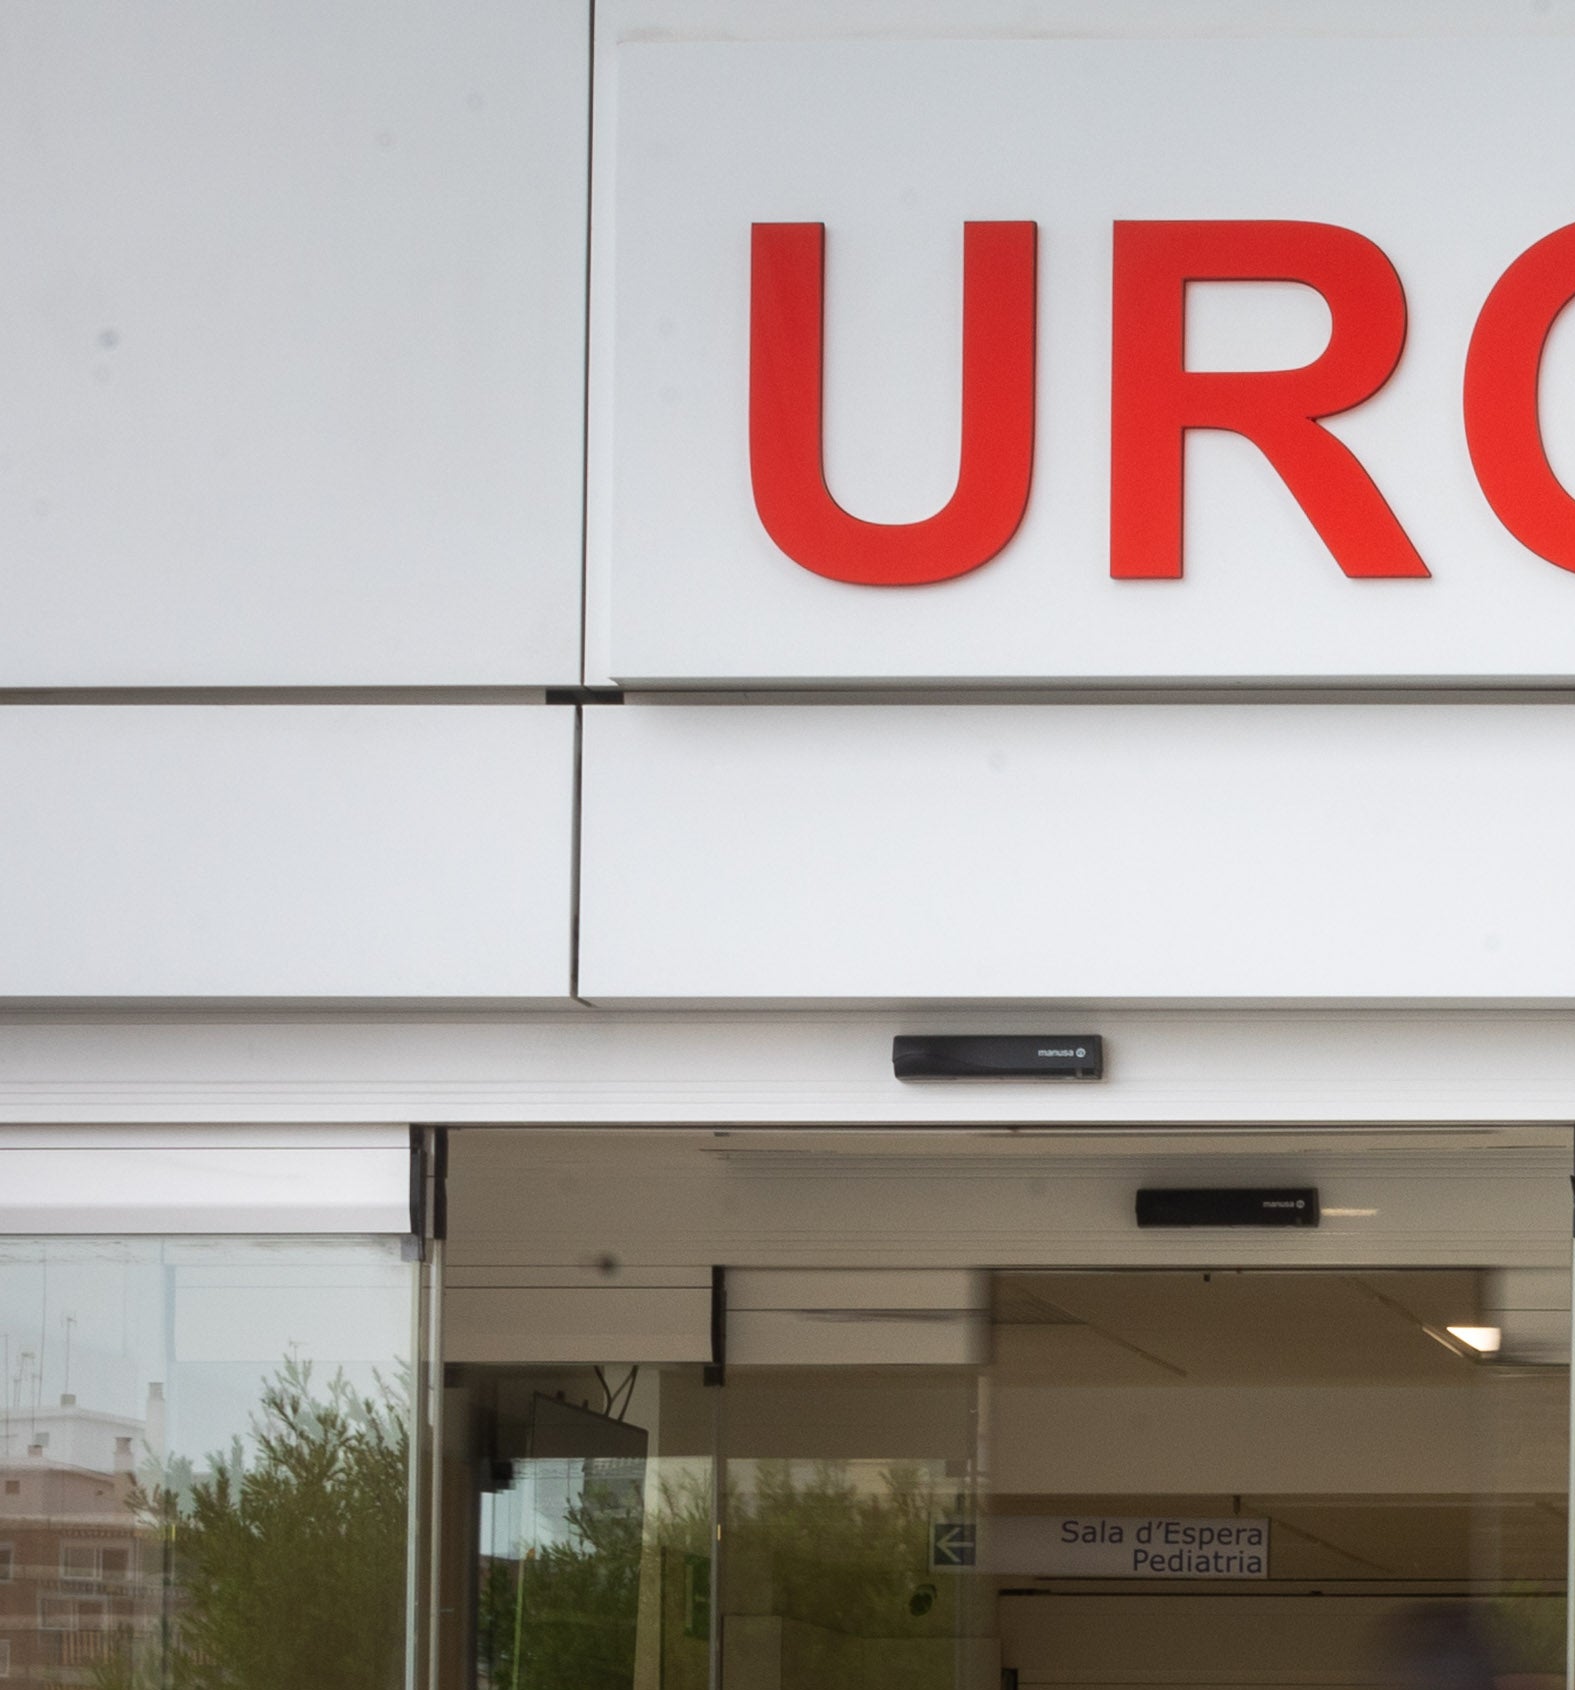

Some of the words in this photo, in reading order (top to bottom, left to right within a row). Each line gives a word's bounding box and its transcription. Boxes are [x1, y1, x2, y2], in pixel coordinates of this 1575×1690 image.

[1037, 1049, 1074, 1057] manusa
[1060, 1520, 1124, 1545] Sala
[1136, 1521, 1263, 1551] d'Espera
[1133, 1549, 1263, 1574] Pediatria
